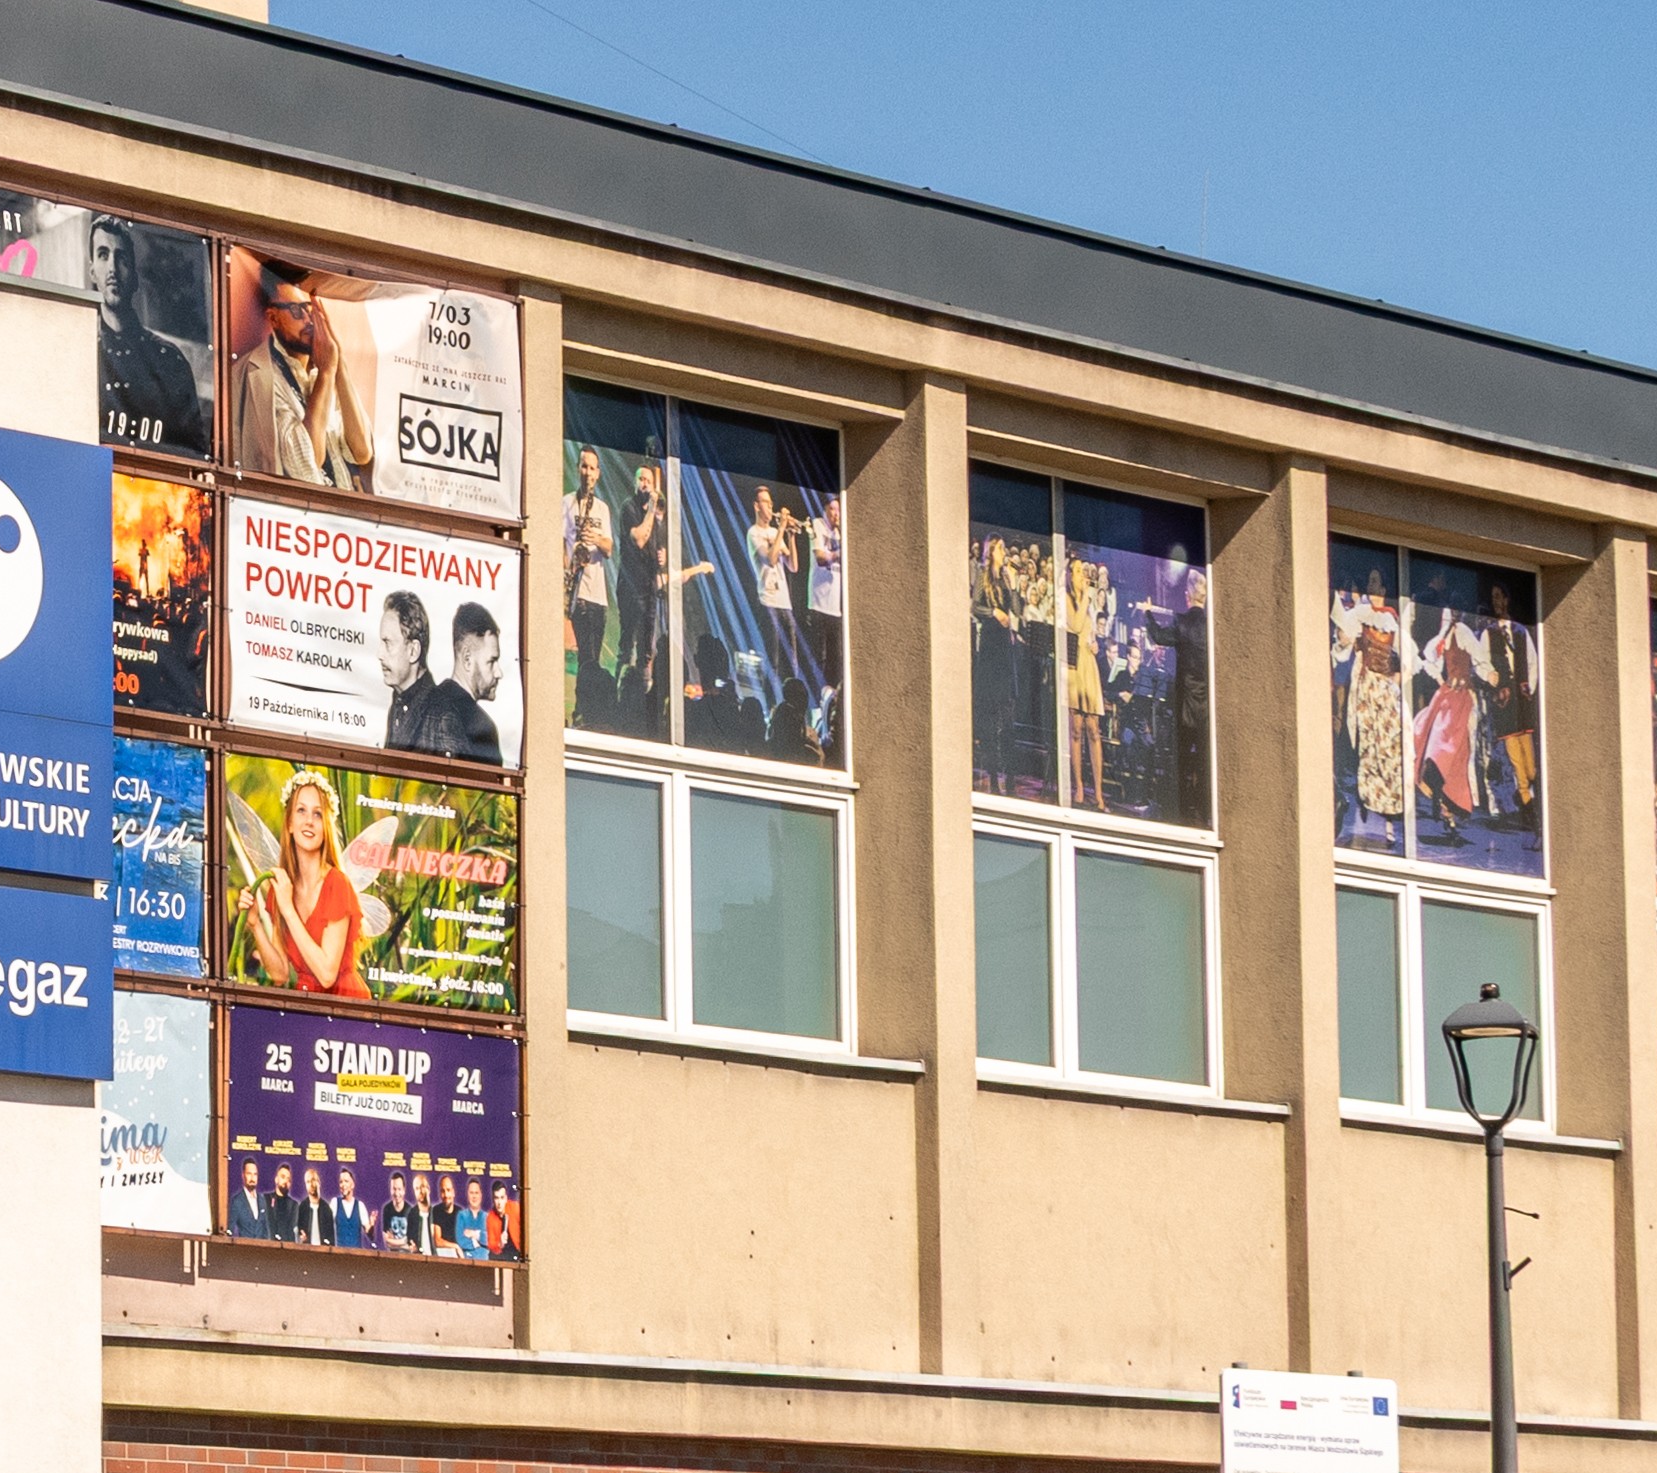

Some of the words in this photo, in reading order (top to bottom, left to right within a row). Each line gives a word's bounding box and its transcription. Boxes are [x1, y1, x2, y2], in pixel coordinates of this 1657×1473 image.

[427, 324, 471, 350] 19:00
[422, 375, 471, 393] MARCIN
[107, 410, 163, 444] 19:00
[400, 407, 498, 468] SÓJKA
[246, 515, 502, 591] NIESPODZIEWANY
[246, 561, 373, 613] POWRÓT
[246, 611, 287, 632] DANIEL
[290, 619, 365, 646] OLBRYCHSKI
[246, 640, 293, 662] TOMASZ
[296, 650, 352, 672] KAROLAK
[249, 696, 260, 710] 19
[263, 697, 329, 722] Października
[338, 712, 366, 728] 18:00
[112, 776, 152, 804] CJA
[356, 794, 403, 813] Premiera
[154, 851, 167, 864] NA
[168, 853, 182, 866] BIS
[349, 840, 508, 886] CALINECZKA
[129, 887, 186, 920] 16:30
[136, 940, 200, 959] ROZRYWKOWEJ
[471, 980, 504, 995] 16:00
[265, 1043, 293, 1073] 25
[313, 1038, 394, 1076] STAND
[398, 1048, 431, 1085] UP
[261, 1077, 294, 1094] MARCA
[341, 1078, 358, 1088] GALA
[456, 1067, 482, 1096] 24
[320, 1091, 353, 1107] BILETY
[354, 1094, 374, 1110] JUŻ
[375, 1100, 389, 1112] OD
[452, 1099, 484, 1116] MARCA
[121, 1171, 165, 1187] ZMYSŁY
